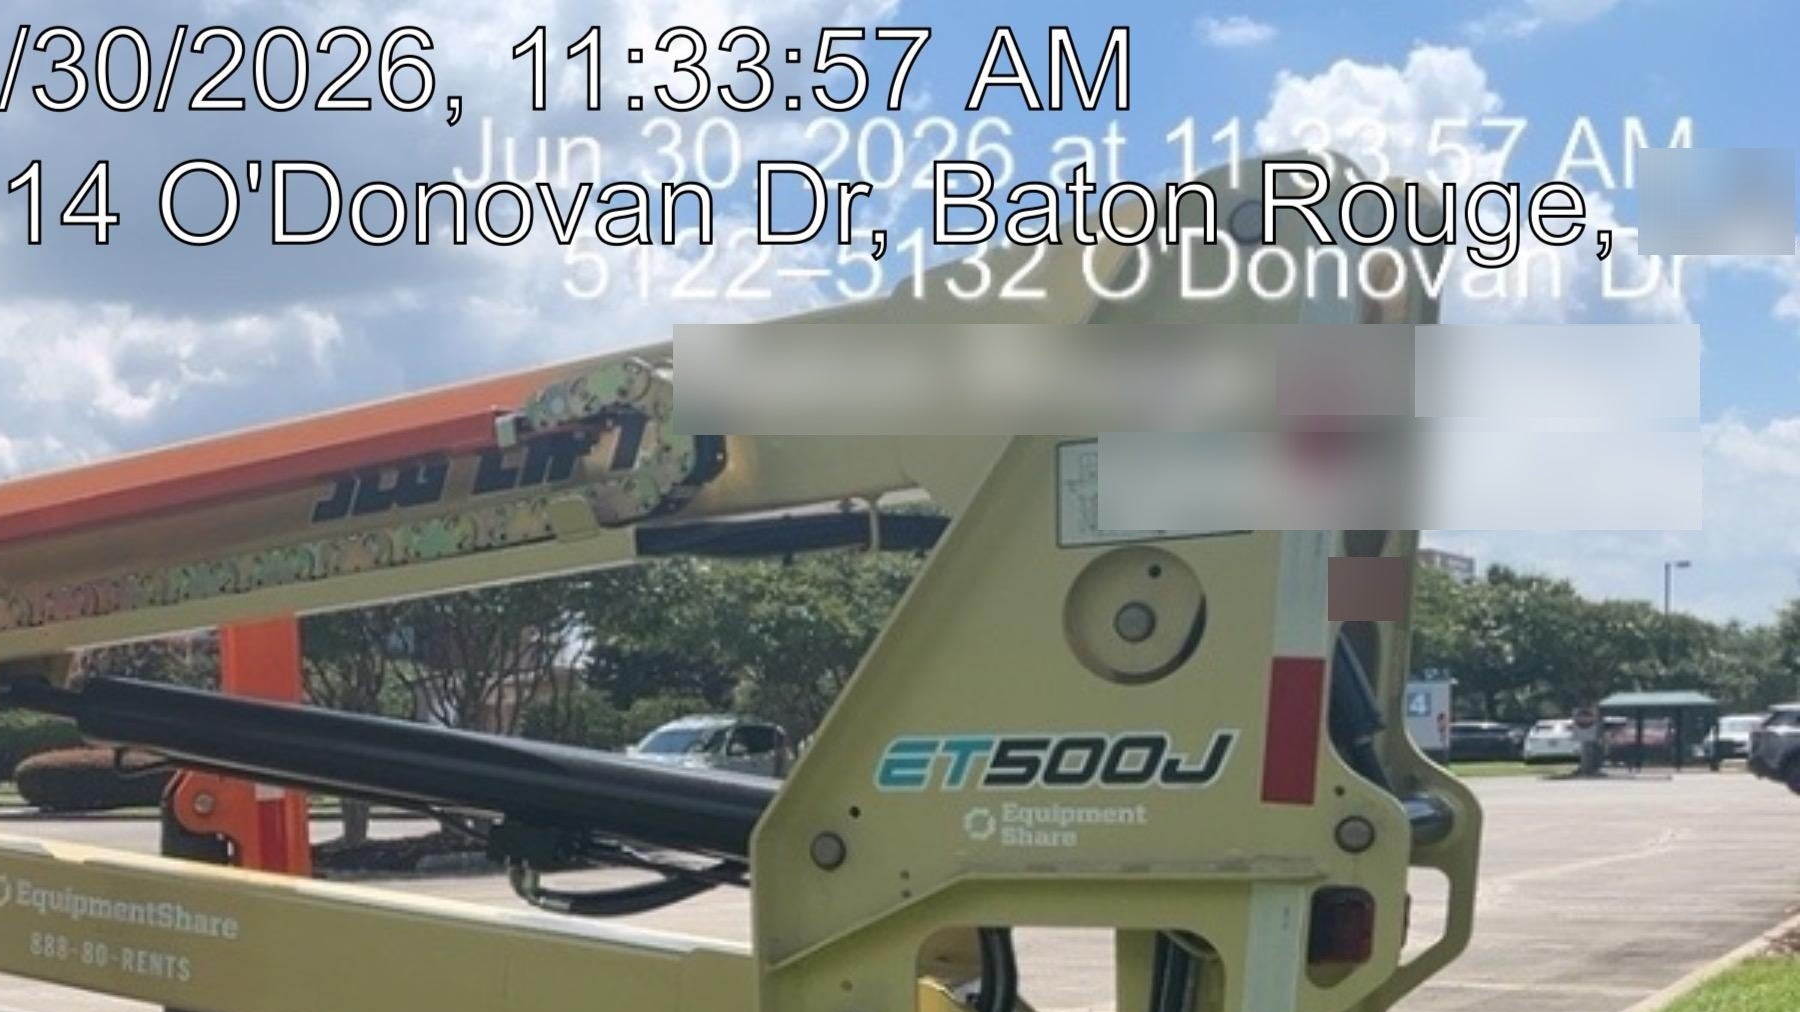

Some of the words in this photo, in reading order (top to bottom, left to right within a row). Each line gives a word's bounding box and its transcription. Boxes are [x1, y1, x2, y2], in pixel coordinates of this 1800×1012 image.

[874, 729, 1241, 793] ET500J
[1000, 802, 1148, 827] Equipment
[1000, 827, 1078, 848] Share
[15, 878, 240, 940] EquipmentShare
[29, 931, 192, 983] 888-80-RENTS
